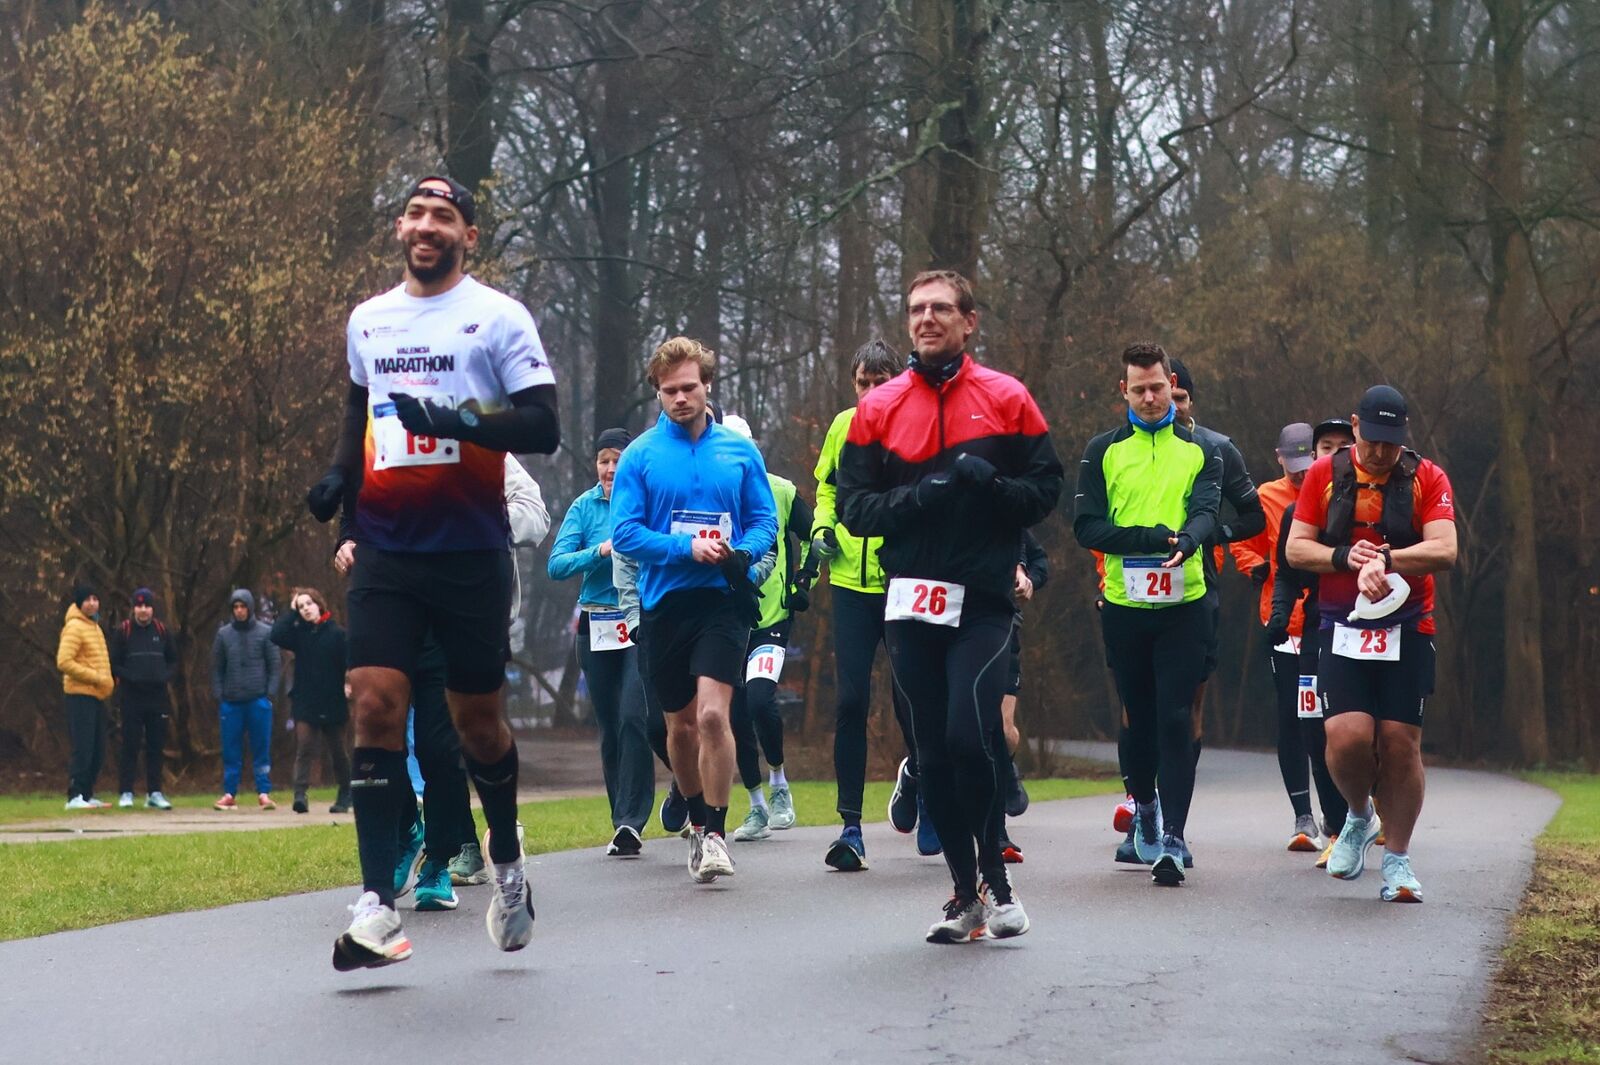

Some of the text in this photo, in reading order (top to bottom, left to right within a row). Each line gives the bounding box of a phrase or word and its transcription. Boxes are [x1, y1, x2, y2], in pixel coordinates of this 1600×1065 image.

[374, 354, 455, 375] MARATHON
[1146, 571, 1172, 596] 24
[912, 584, 948, 616] 26
[1359, 628, 1387, 654] 23
[758, 656, 774, 674] 14
[1300, 690, 1317, 712] 19
